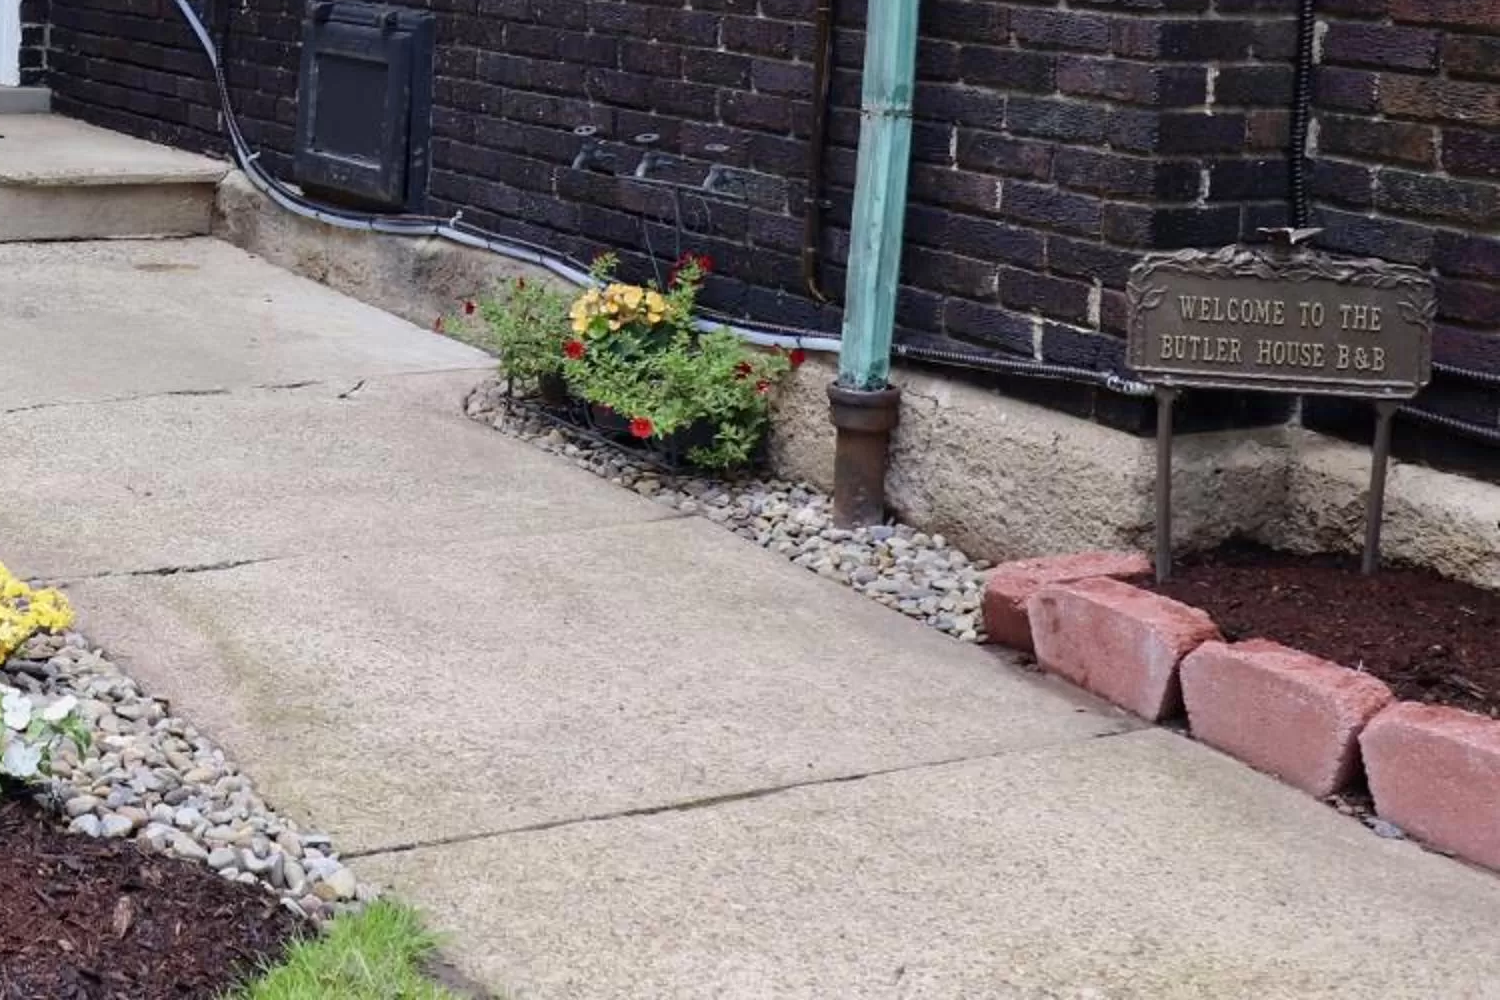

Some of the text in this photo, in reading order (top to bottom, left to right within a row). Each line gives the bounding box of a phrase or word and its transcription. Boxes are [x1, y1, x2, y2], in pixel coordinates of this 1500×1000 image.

[1178, 295, 1382, 331] WELCOME TO THE
[1159, 334, 1386, 371] BUTLER HOUSE B&B
